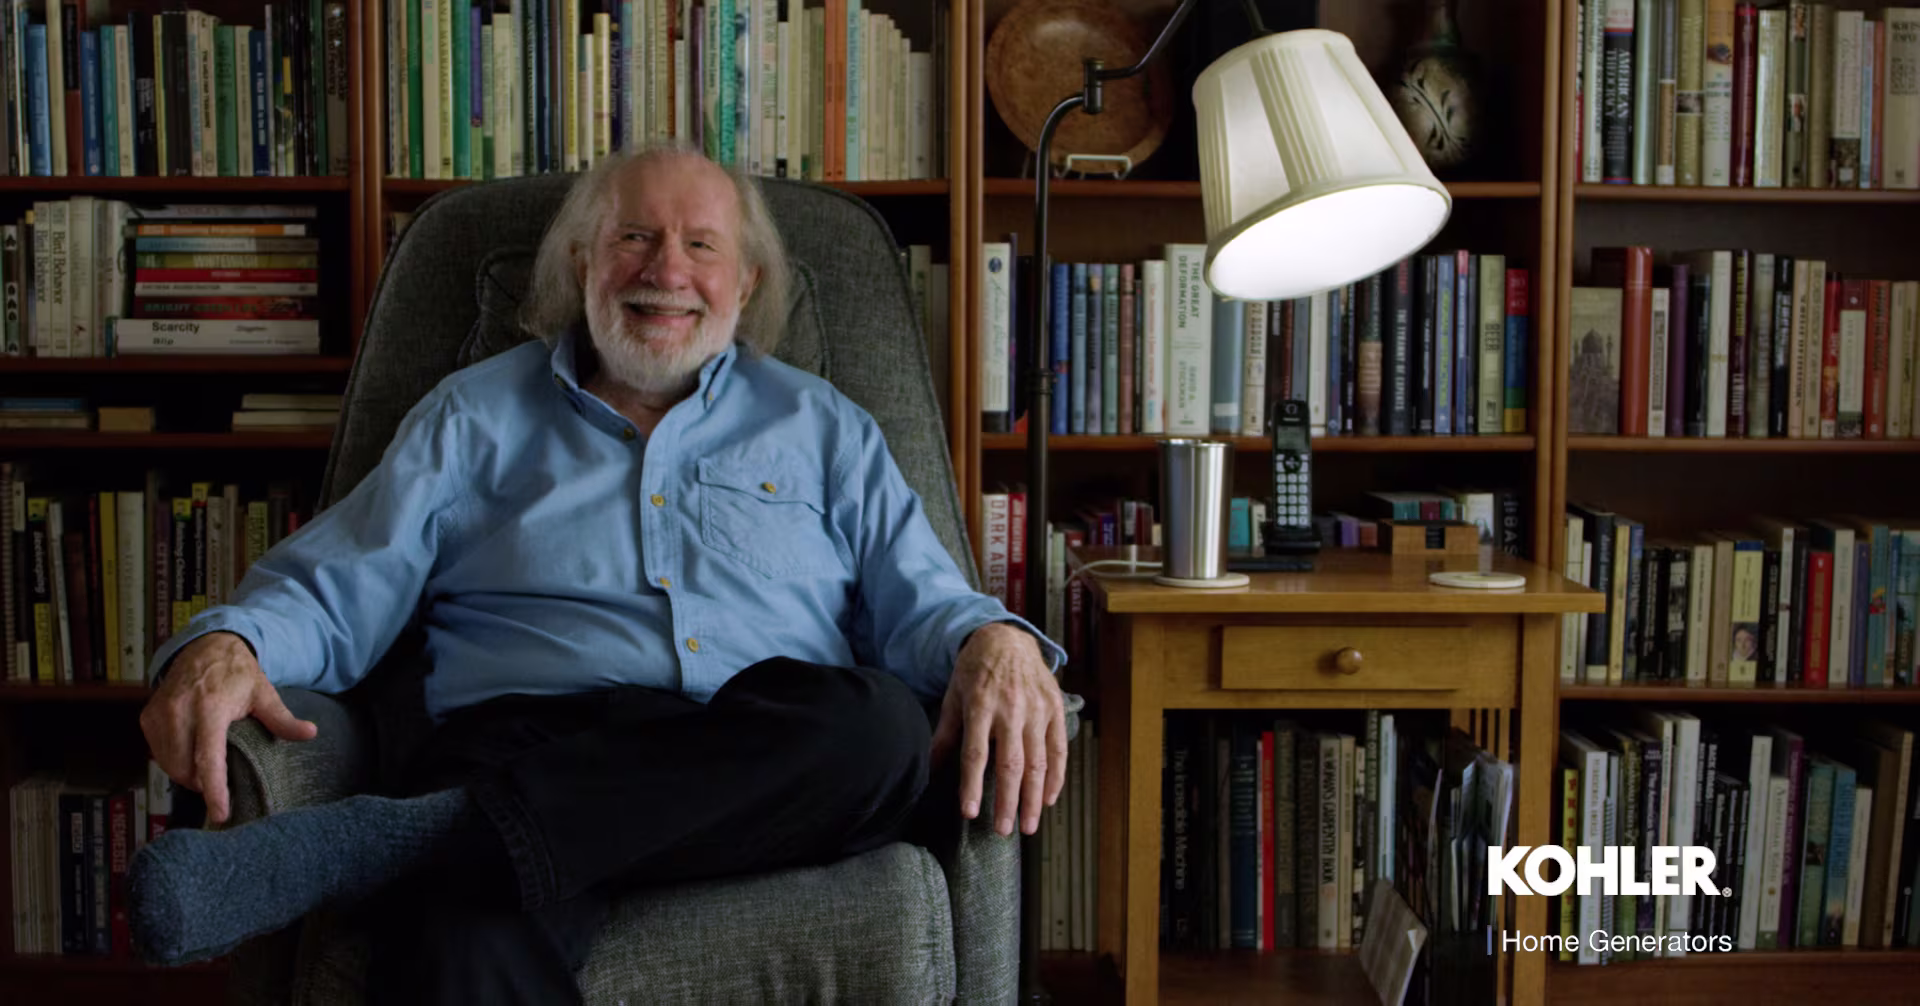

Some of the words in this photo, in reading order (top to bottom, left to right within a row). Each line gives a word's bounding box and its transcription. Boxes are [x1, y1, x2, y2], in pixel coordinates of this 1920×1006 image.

[1604, 48, 1617, 119] THEOCRACY
[1617, 48, 1631, 119] AMERICAN
[36, 230, 48, 253] Bird
[53, 231, 66, 255] Bird
[36, 256, 49, 303] Behavior
[53, 257, 66, 304] Behavior
[1190, 262, 1200, 281] THE
[1178, 256, 1188, 329] DEFORMATION
[1190, 284, 1200, 319] GREAT
[152, 322, 200, 335] Scarcity
[1395, 309, 1407, 324] THE
[1395, 326, 1407, 361] TYRANNY
[1484, 322, 1501, 352] BEER
[1395, 365, 1406, 375] OF
[1394, 377, 1406, 411] EXPERTS
[990, 500, 1006, 545] DARK
[33, 531, 47, 594] Beekeeping
[156, 543, 168, 577] CITY
[990, 552, 1005, 595] AGES
[175, 558, 186, 601] Chickens
[1071, 580, 1082, 613] STATE
[156, 580, 168, 637] CHICKS
[1174, 749, 1187, 769] The
[1707, 744, 1718, 769] BACK
[1648, 772, 1658, 788] The
[1705, 770, 1716, 800] ROADS
[1174, 774, 1187, 833] Incredible
[1646, 790, 1657, 829] American
[1772, 787, 1786, 847] American
[1836, 783, 1855, 829] SHIRLEY
[112, 813, 127, 873] NEMESIS
[1831, 830, 1852, 879] JACKSON
[1174, 836, 1187, 890] Machine
[1321, 858, 1336, 885] BOOK
